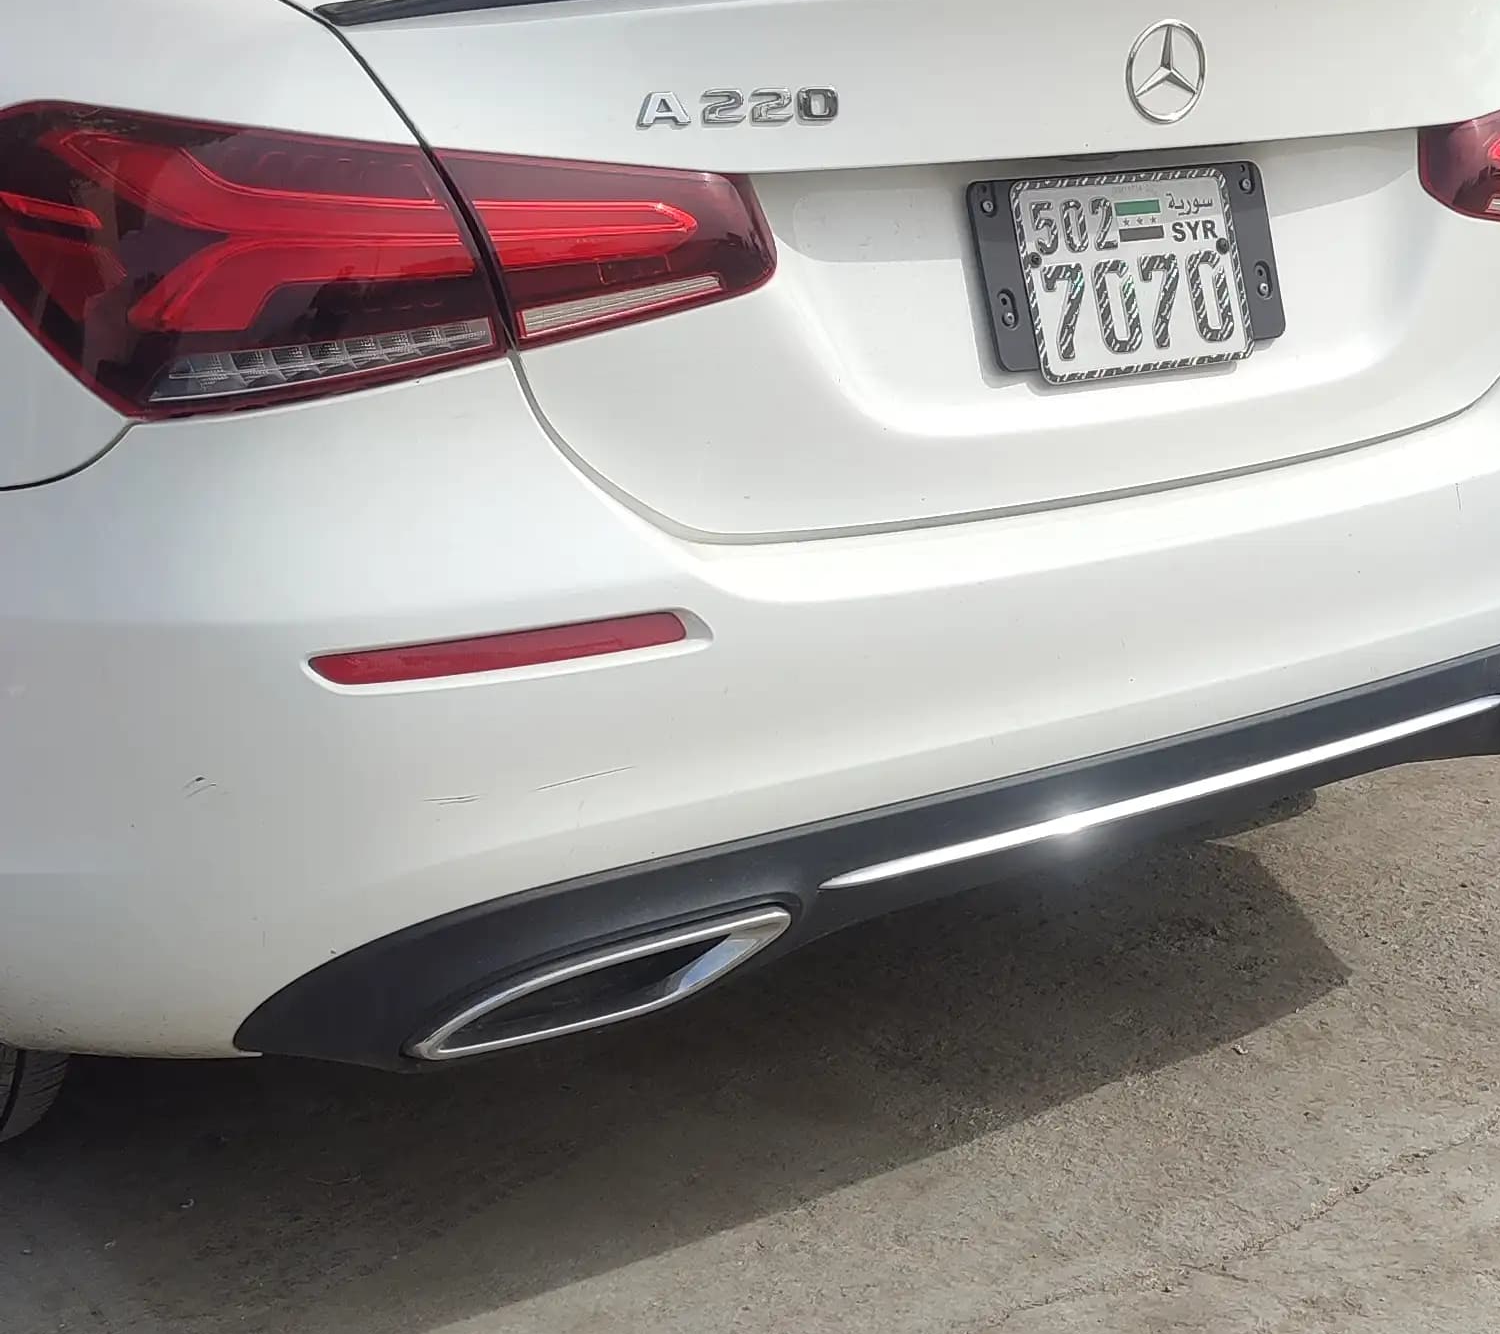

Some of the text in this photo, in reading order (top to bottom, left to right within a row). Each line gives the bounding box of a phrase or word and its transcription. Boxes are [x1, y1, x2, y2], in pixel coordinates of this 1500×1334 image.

[1165, 192, 1214, 216] سورية
[1028, 196, 1121, 254] 502
[1171, 220, 1219, 244] SYR
[1039, 249, 1237, 361] 7070
